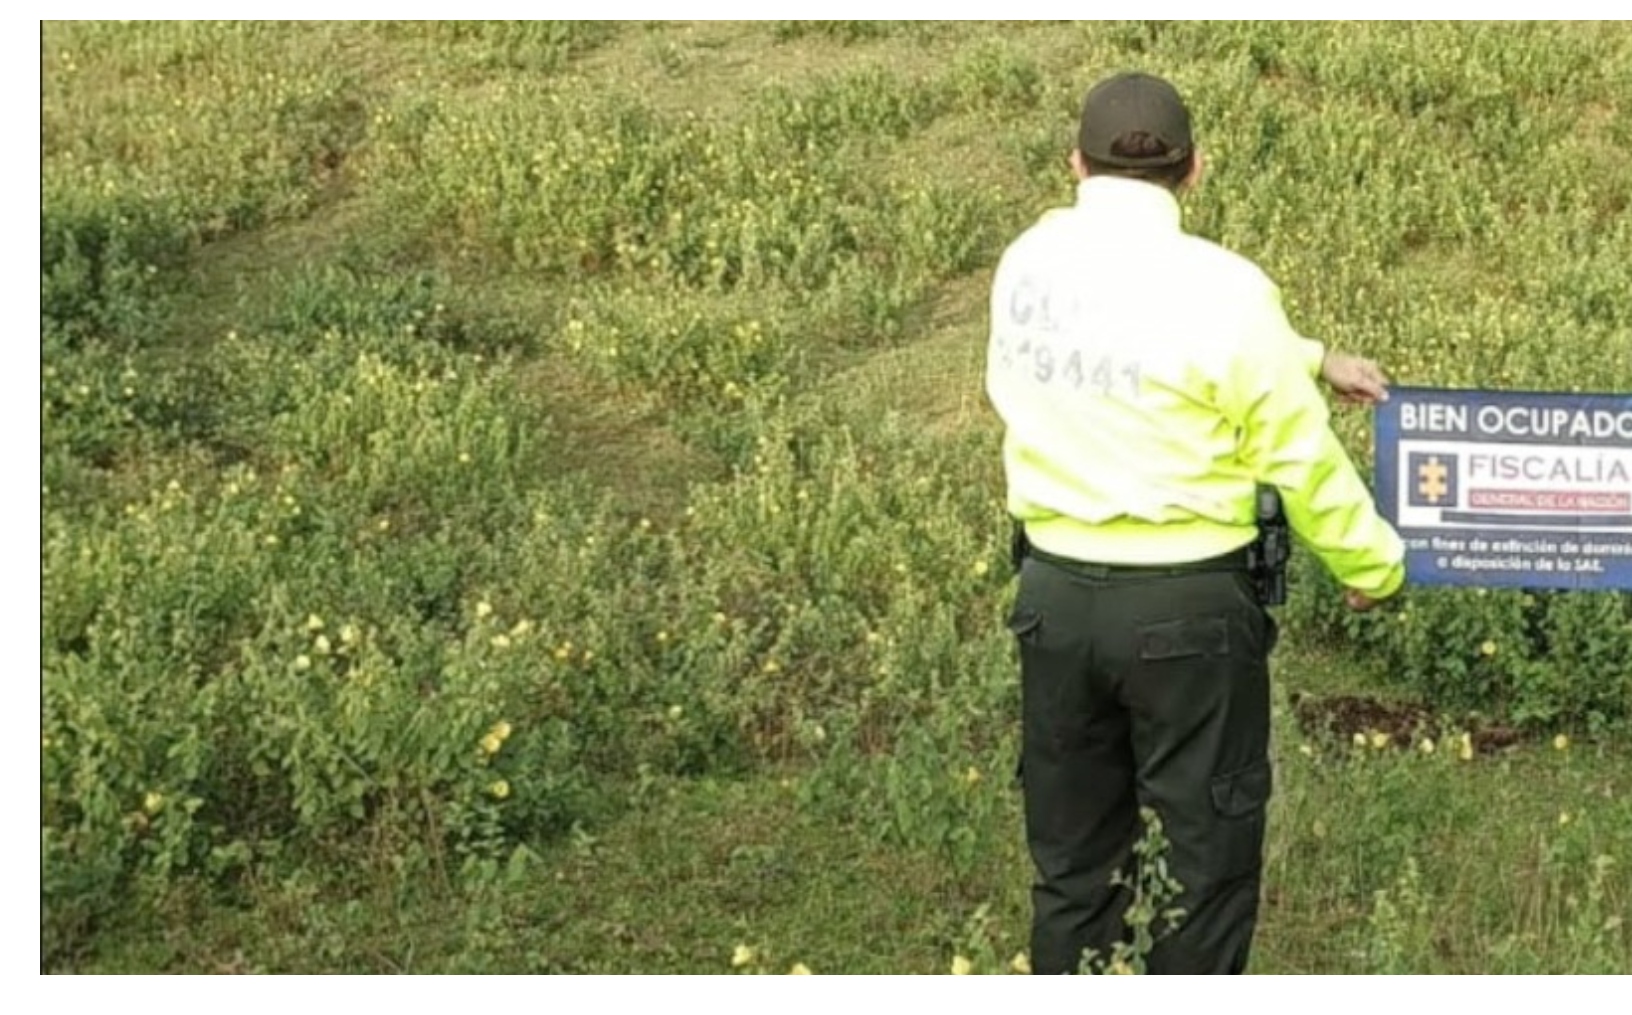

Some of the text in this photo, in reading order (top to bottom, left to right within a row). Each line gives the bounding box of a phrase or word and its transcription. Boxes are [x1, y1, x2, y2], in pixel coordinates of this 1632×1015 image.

[1399, 402, 1468, 432] BIEN
[1468, 452, 1630, 482] FISCALÍA
[1469, 538, 1488, 552] de
[1560, 540, 1579, 554] de
[1534, 557, 1553, 571] de
